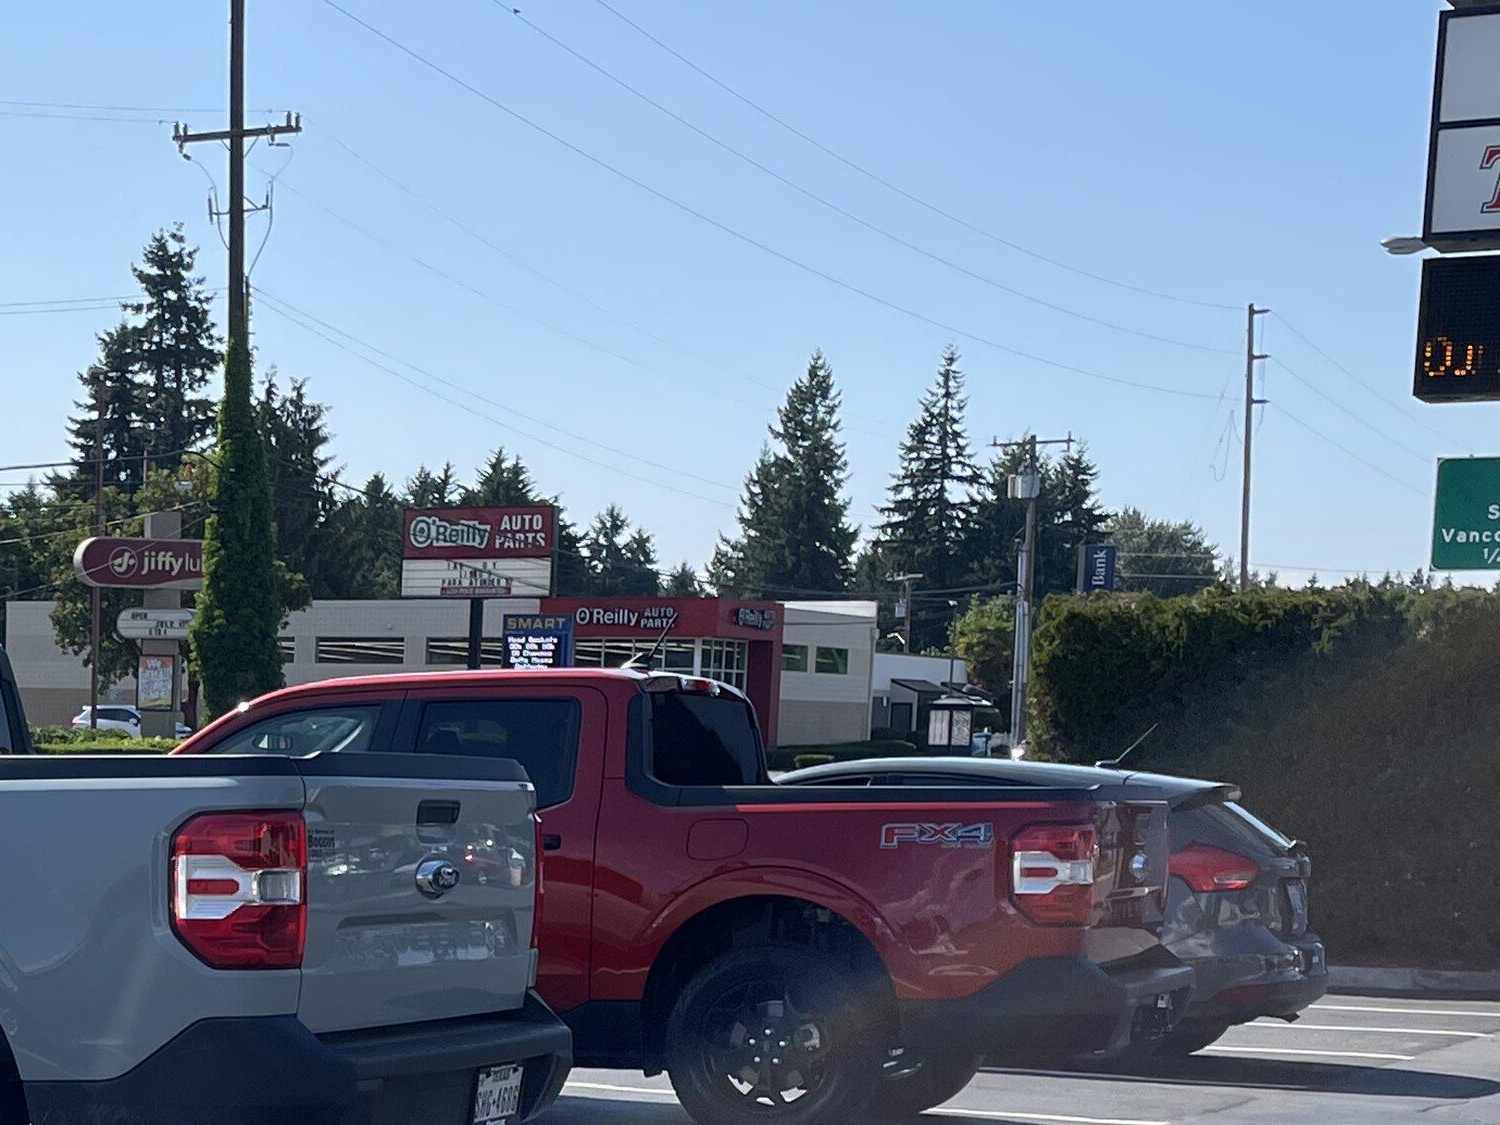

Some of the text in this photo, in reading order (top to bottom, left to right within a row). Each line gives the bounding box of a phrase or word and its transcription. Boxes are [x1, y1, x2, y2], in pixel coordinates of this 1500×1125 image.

[410, 514, 543, 549] O'Reilly AUTO
[495, 532, 546, 549] PARTS
[1091, 549, 1107, 586] Bank
[507, 617, 566, 630] SMART
[575, 607, 675, 626] O'Reilly AUTO
[880, 823, 994, 849] FX4
